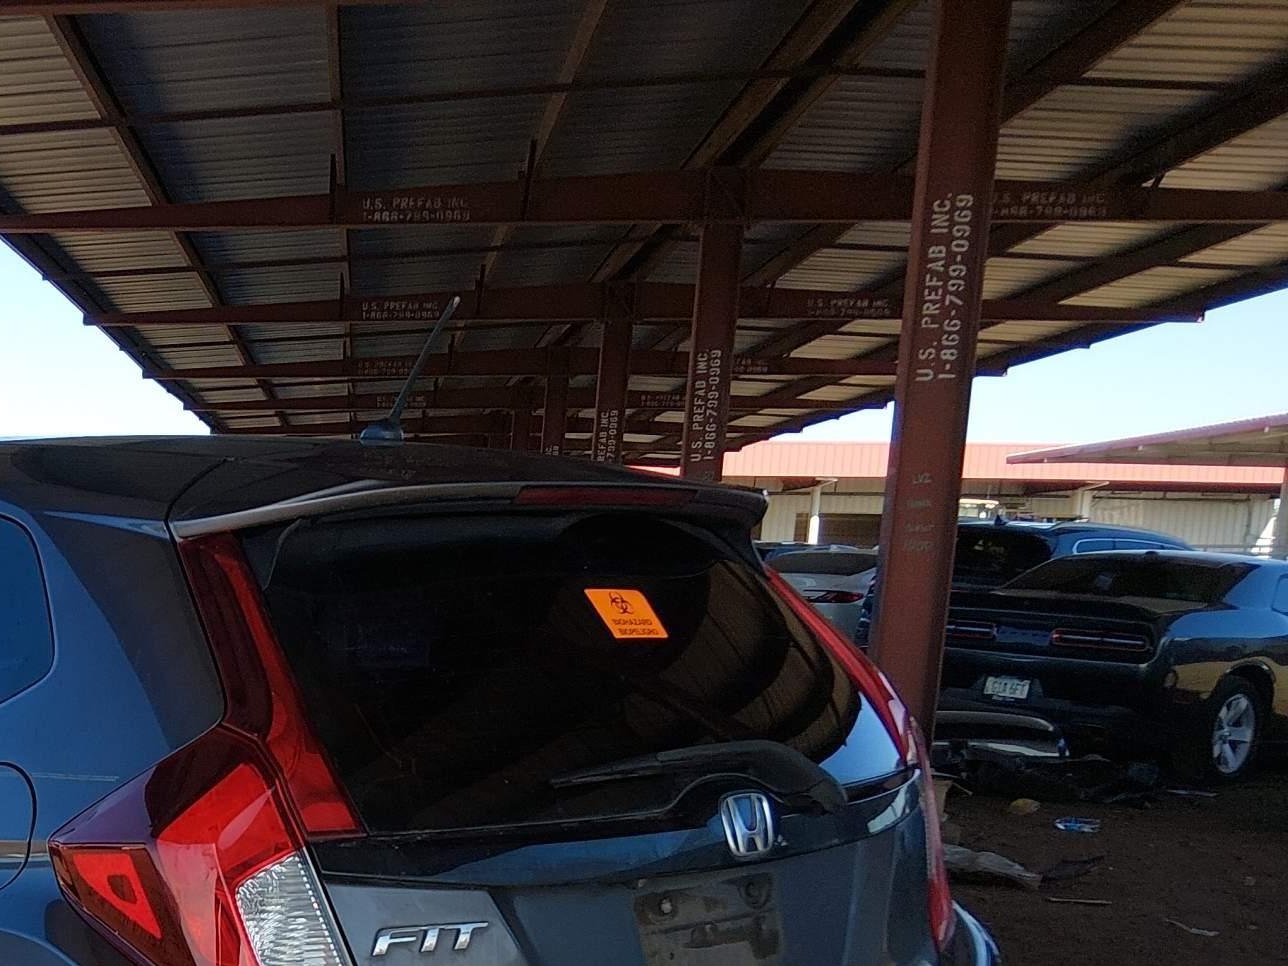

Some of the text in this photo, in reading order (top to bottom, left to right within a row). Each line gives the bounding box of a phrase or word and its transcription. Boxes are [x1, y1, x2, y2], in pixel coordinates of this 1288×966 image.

[915, 192, 953, 382] U.S. PREFAB INC.
[937, 194, 974, 380] 1-866-799-0969
[372, 921, 489, 956] FIT
